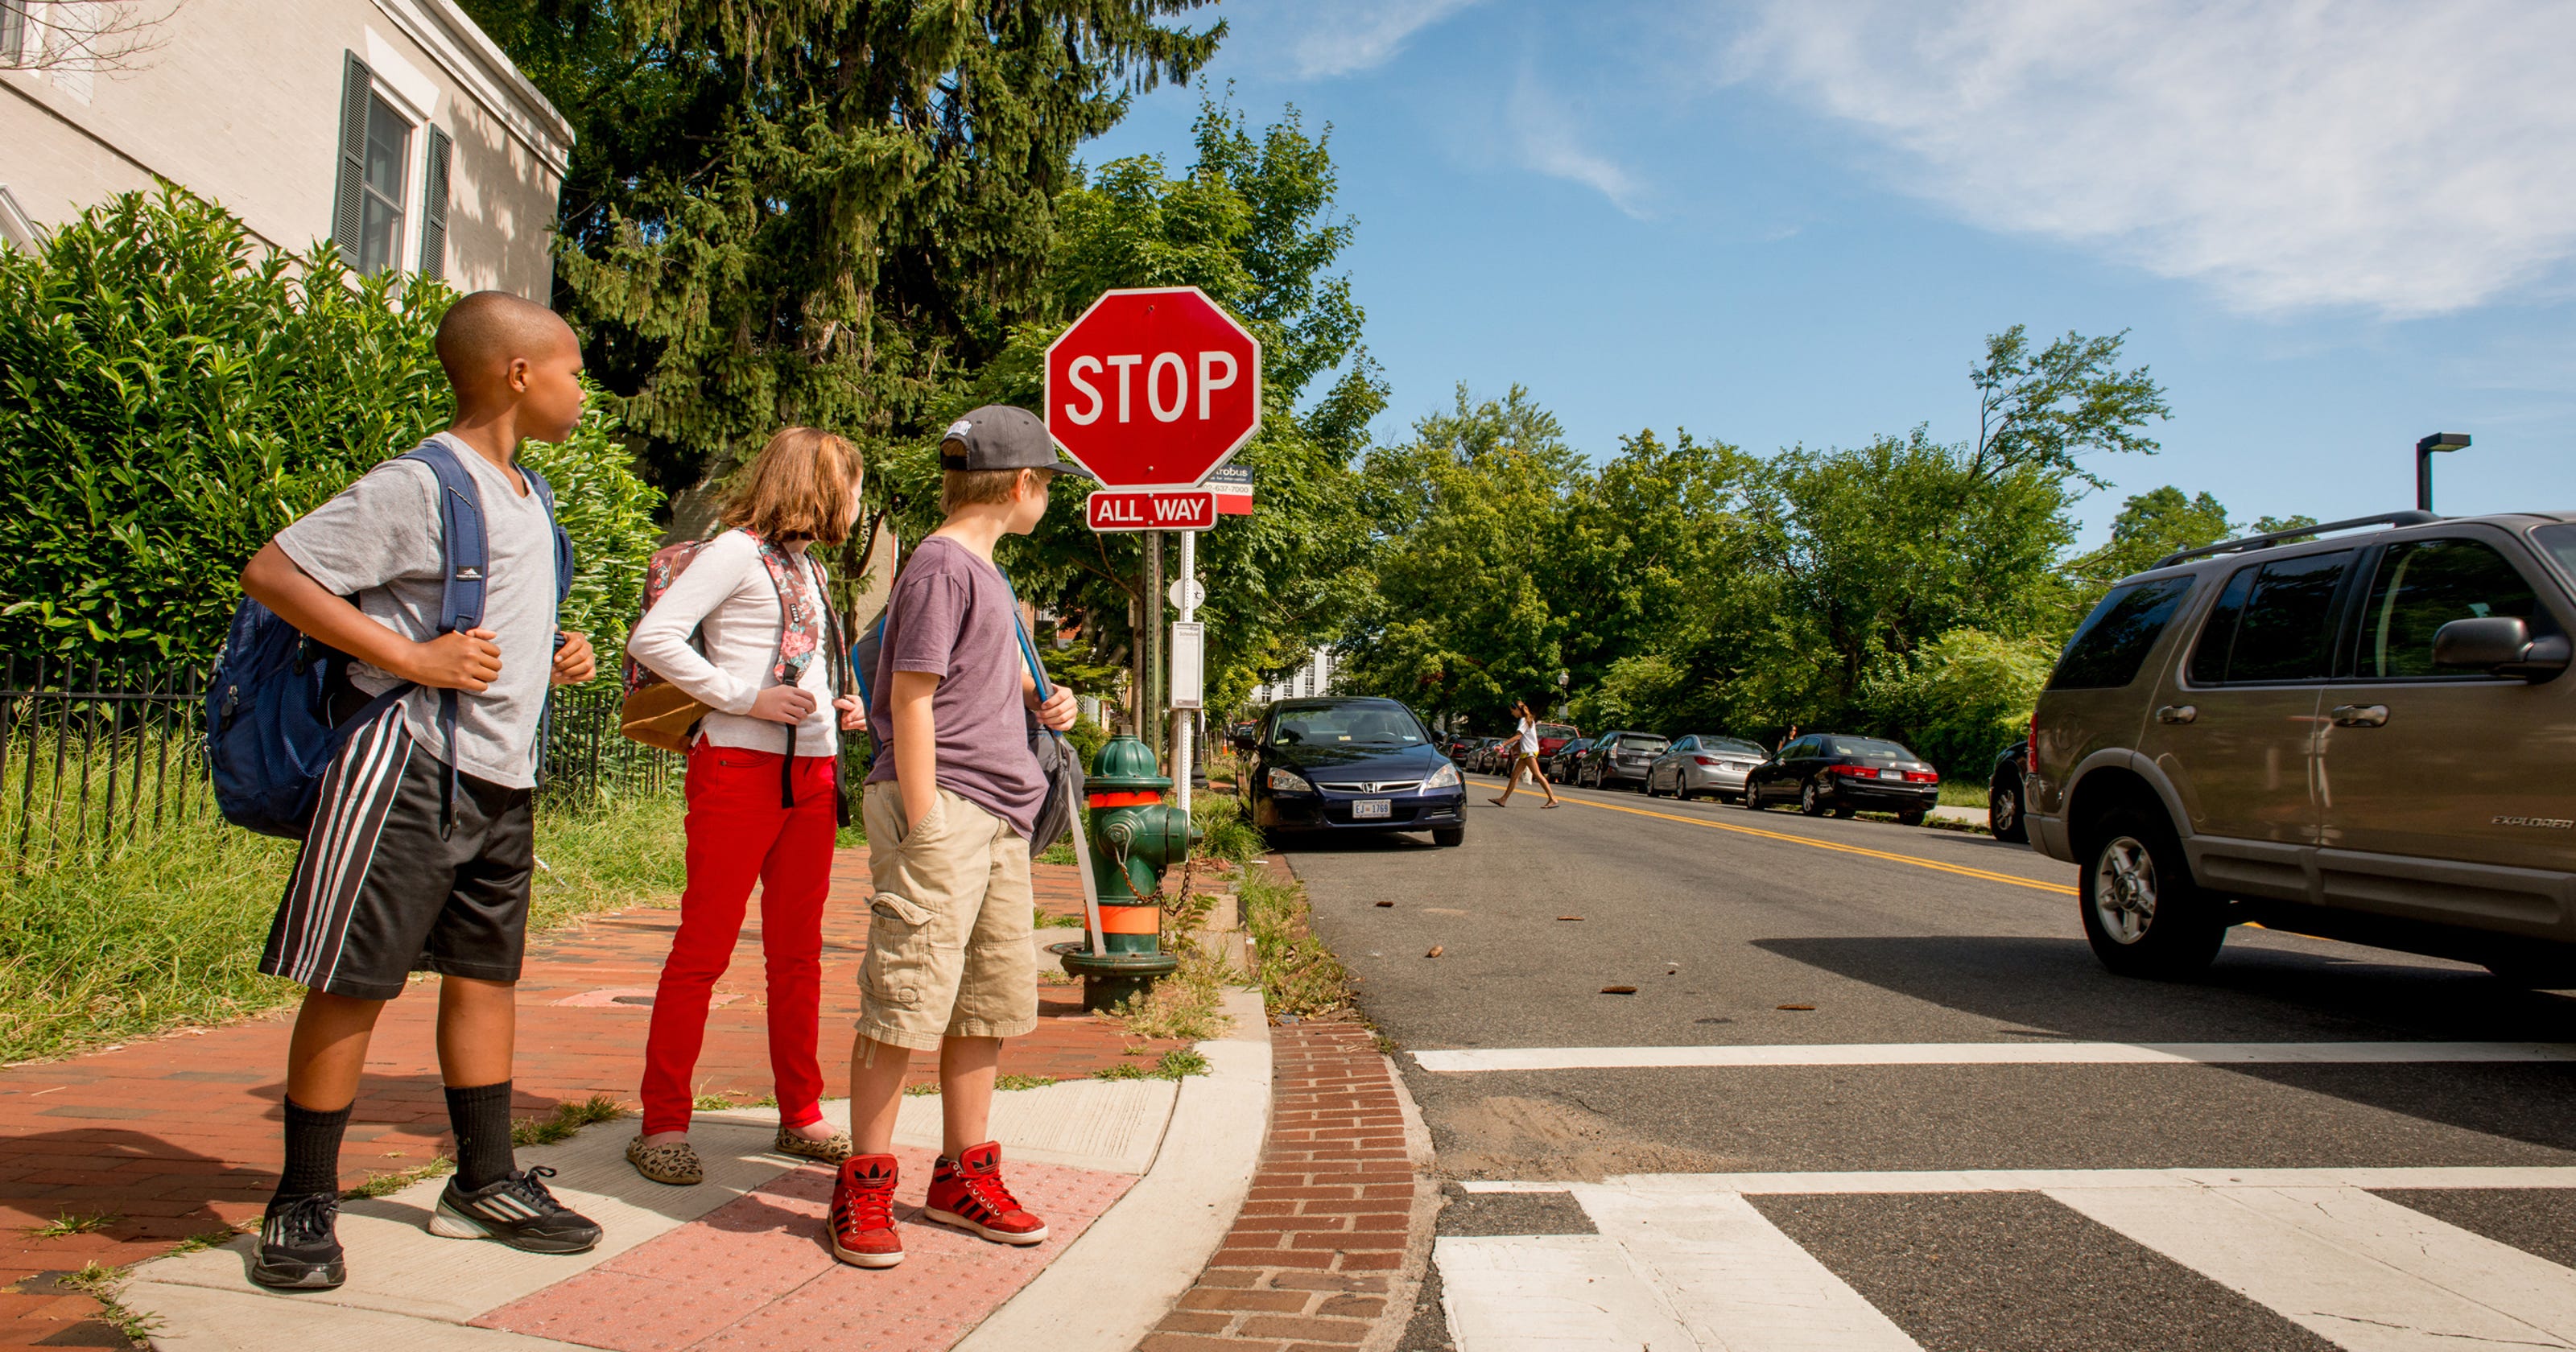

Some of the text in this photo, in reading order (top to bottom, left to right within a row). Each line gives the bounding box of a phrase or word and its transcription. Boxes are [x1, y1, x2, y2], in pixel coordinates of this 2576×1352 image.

[1065, 350, 1238, 426] STOP
[1216, 467, 1249, 476] trobus
[1203, 484, 1249, 493] 02-637-7000
[1096, 498, 1206, 521] ALL WAY
[1356, 804, 1389, 814] EJ 1769
[2491, 815, 2575, 830] EXPLORER
